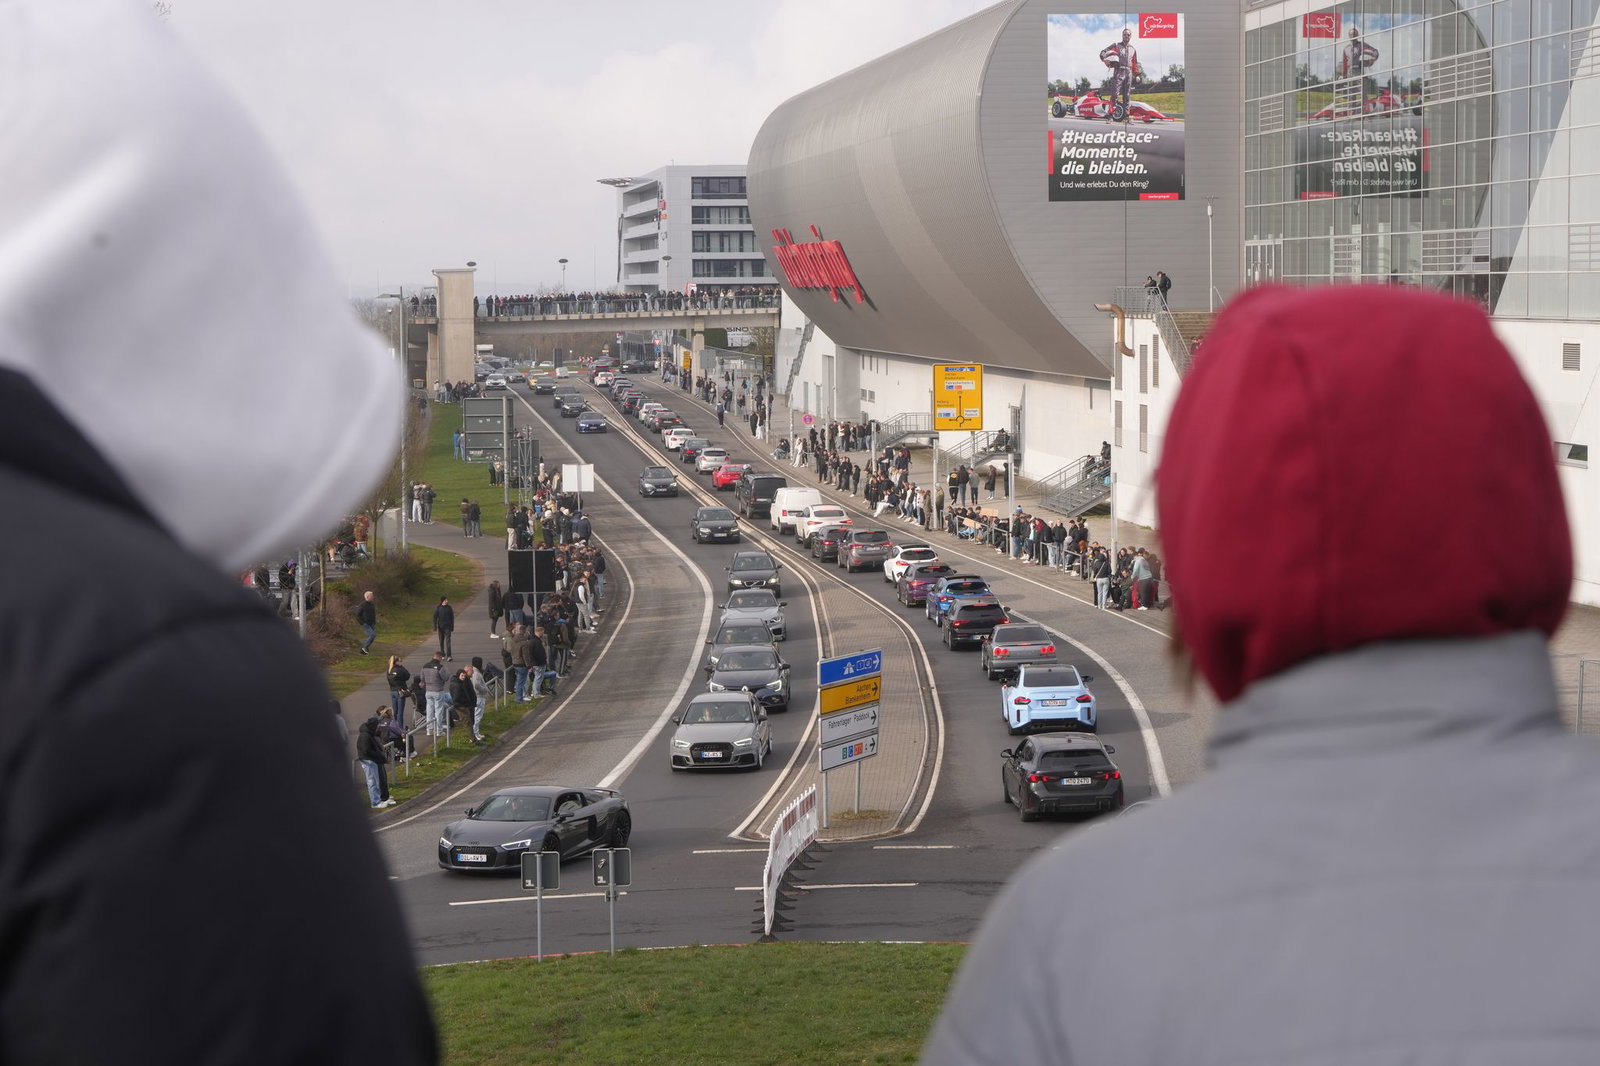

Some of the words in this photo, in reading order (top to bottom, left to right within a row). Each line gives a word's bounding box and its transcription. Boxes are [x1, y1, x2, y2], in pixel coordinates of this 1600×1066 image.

[1061, 129, 1159, 144] #HeartRace-
[1061, 145, 1138, 161] Momente,
[1061, 161, 1085, 175] die
[1088, 160, 1148, 174] bleiben.
[1060, 181, 1073, 189] Und
[1074, 181, 1086, 189] wie
[1119, 180, 1132, 188] den
[1132, 180, 1150, 189] Ring?
